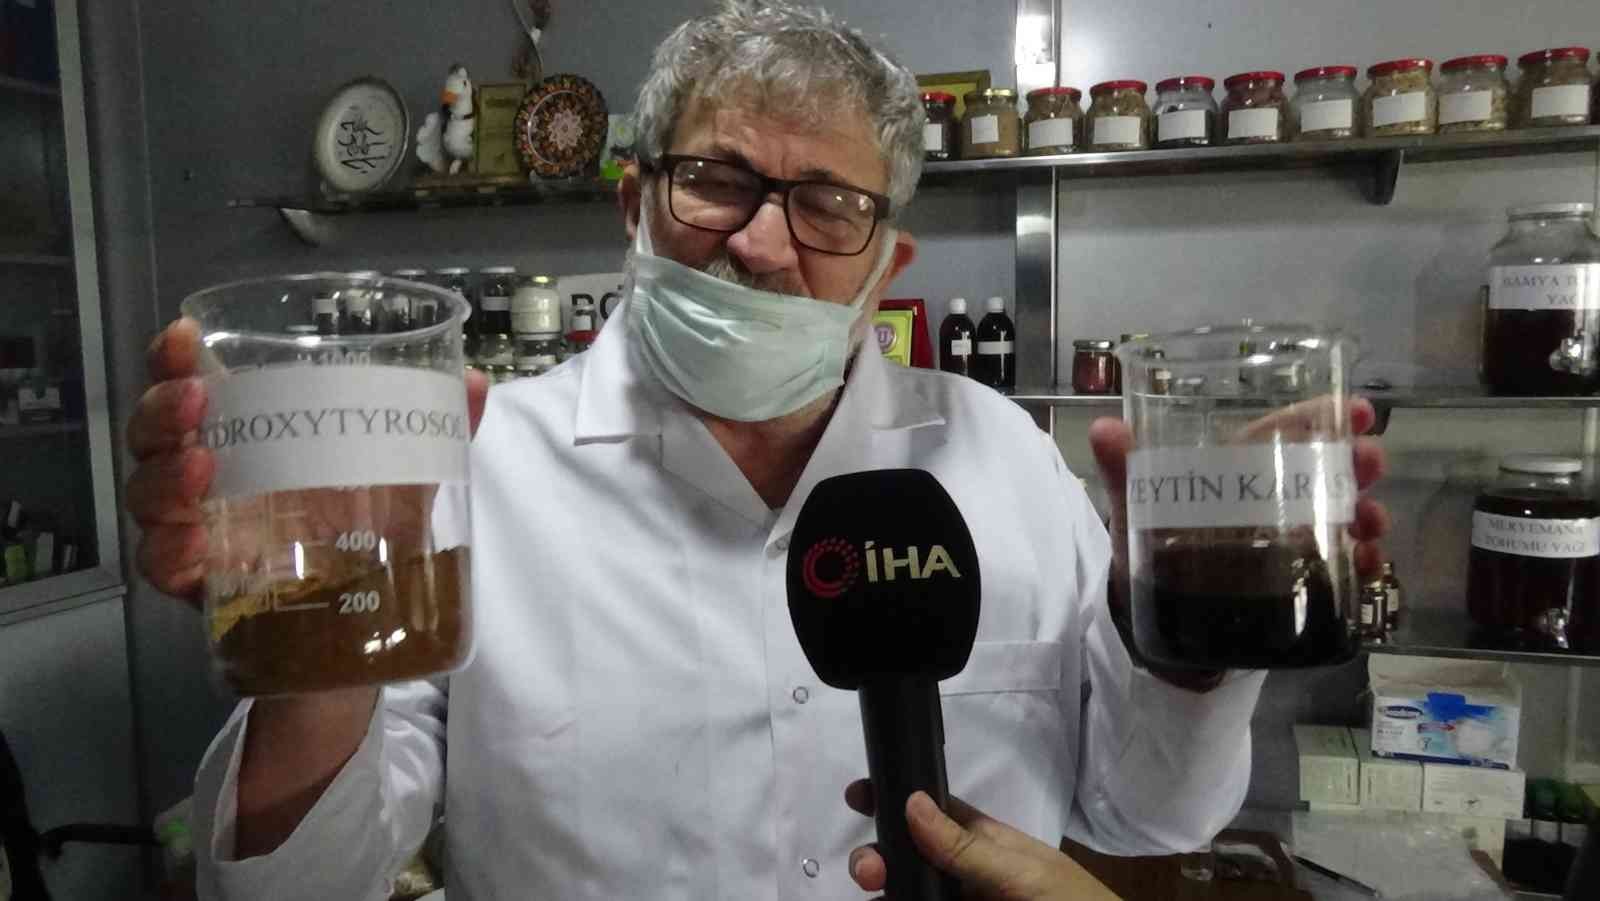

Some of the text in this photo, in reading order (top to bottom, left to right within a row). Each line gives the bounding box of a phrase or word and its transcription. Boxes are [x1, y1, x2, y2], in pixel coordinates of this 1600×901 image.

[336, 530, 376, 552] 400
[864, 540, 961, 582] İHA
[338, 591, 381, 614] 200
